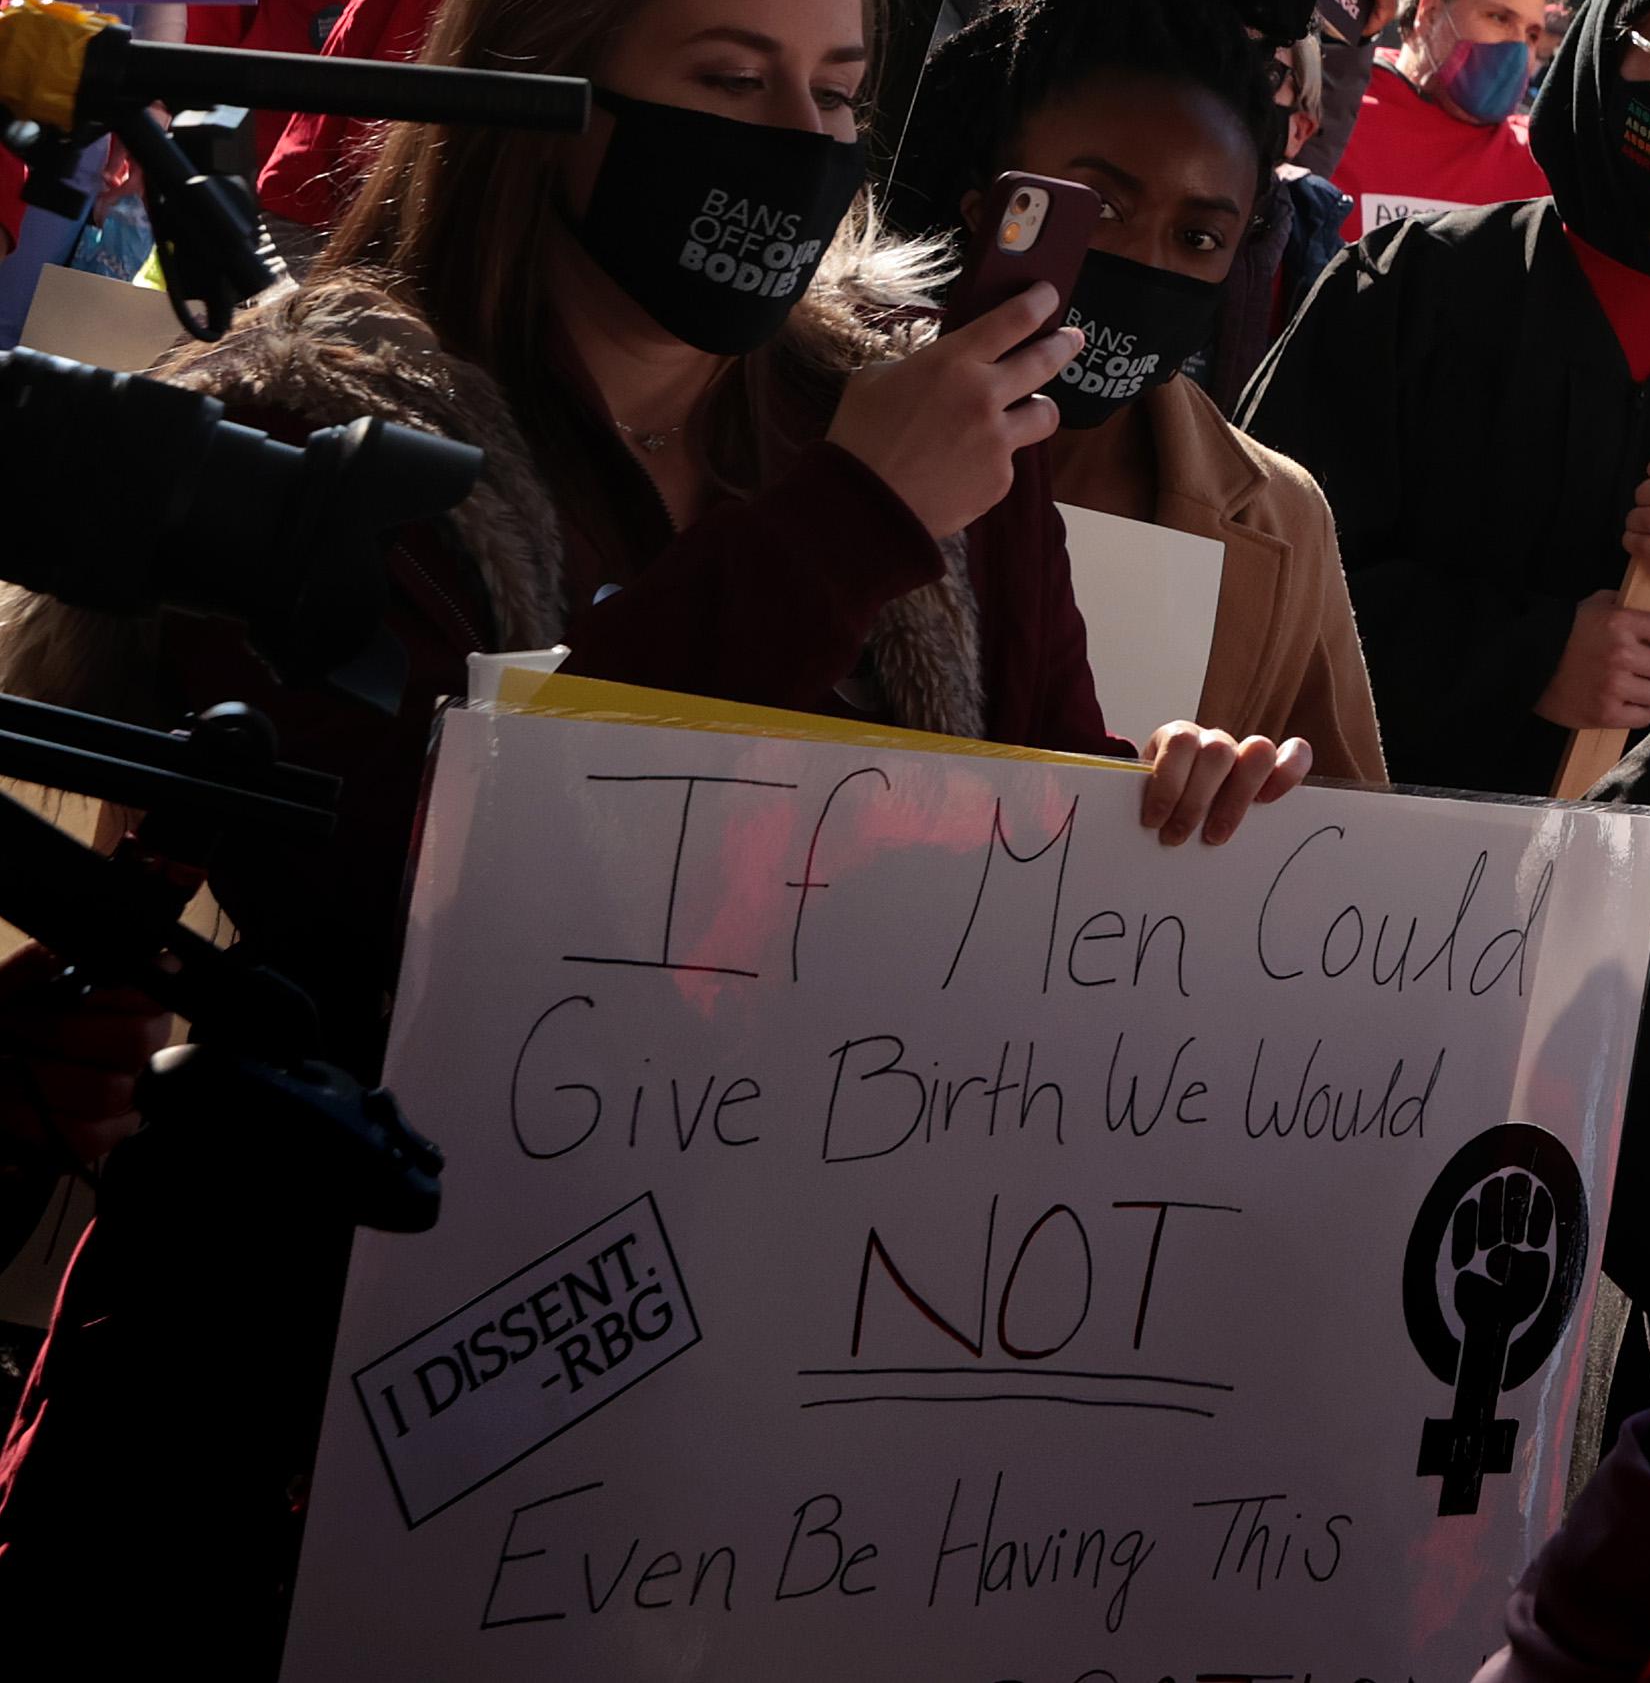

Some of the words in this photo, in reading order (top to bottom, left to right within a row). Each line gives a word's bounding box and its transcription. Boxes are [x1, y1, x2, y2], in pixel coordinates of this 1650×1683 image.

[690, 216, 760, 258] OFF
[763, 239, 822, 270] OUR
[702, 189, 800, 241] BANS
[679, 240, 801, 298] BODIES
[1064, 308, 1137, 355] BANS
[1105, 353, 1160, 378] OUR
[1059, 362, 1145, 399] ODIES
[563, 767, 891, 983] If
[941, 792, 1189, 997] Men
[1256, 825, 1554, 1000] Could
[510, 996, 762, 1160] Give
[822, 1033, 1065, 1165] Birth
[1104, 1031, 1209, 1140] We
[1245, 1037, 1447, 1144] Would
[851, 1194, 1243, 1361] NOT
[380, 1385, 411, 1438] I
[413, 1232, 658, 1419] DISSENT.
[541, 1282, 674, 1394] -RBG
[480, 1481, 737, 1631] Even
[777, 1492, 880, 1607] Be
[929, 1470, 1156, 1634] Having
[1193, 1492, 1353, 1589] This
